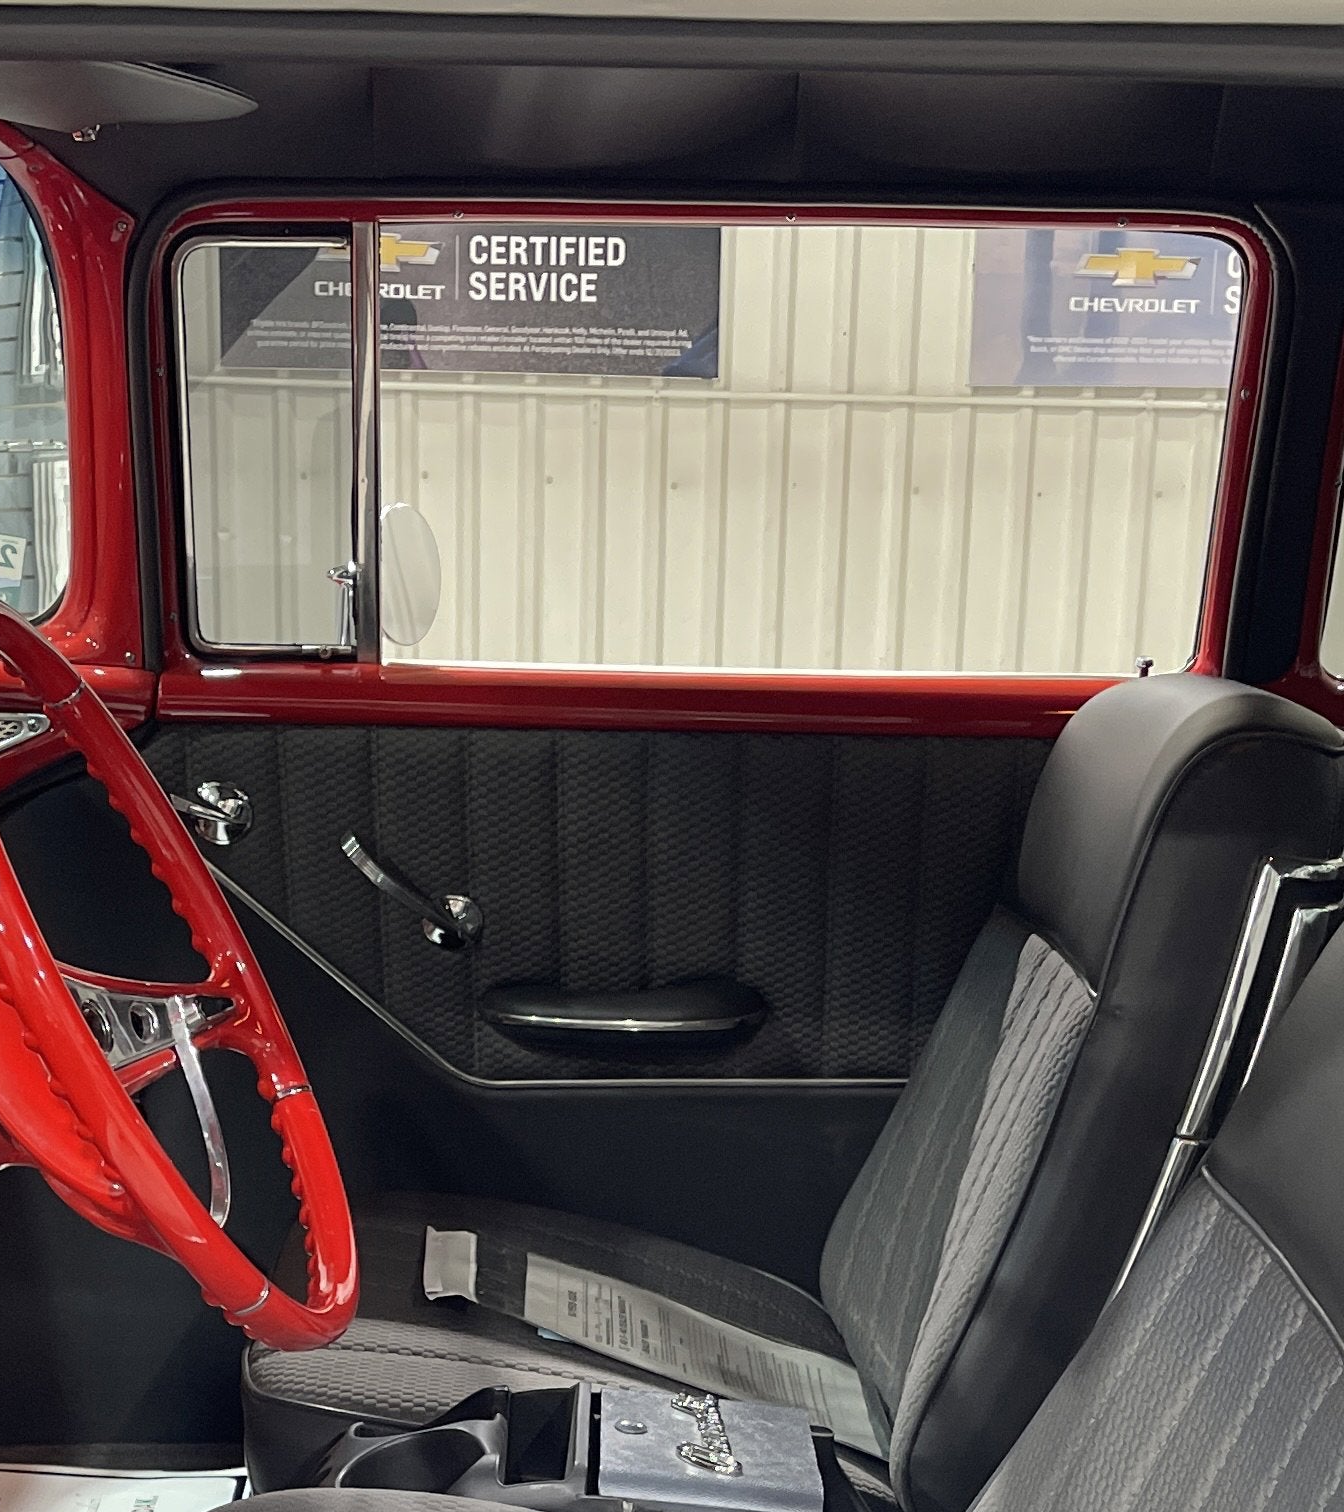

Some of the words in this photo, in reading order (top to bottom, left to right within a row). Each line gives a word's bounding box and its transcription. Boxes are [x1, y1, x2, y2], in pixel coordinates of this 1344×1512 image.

[468, 235, 626, 267] CERTIFIED
[468, 271, 598, 302] SERVICE
[1068, 296, 1200, 314] CHEVROLET
